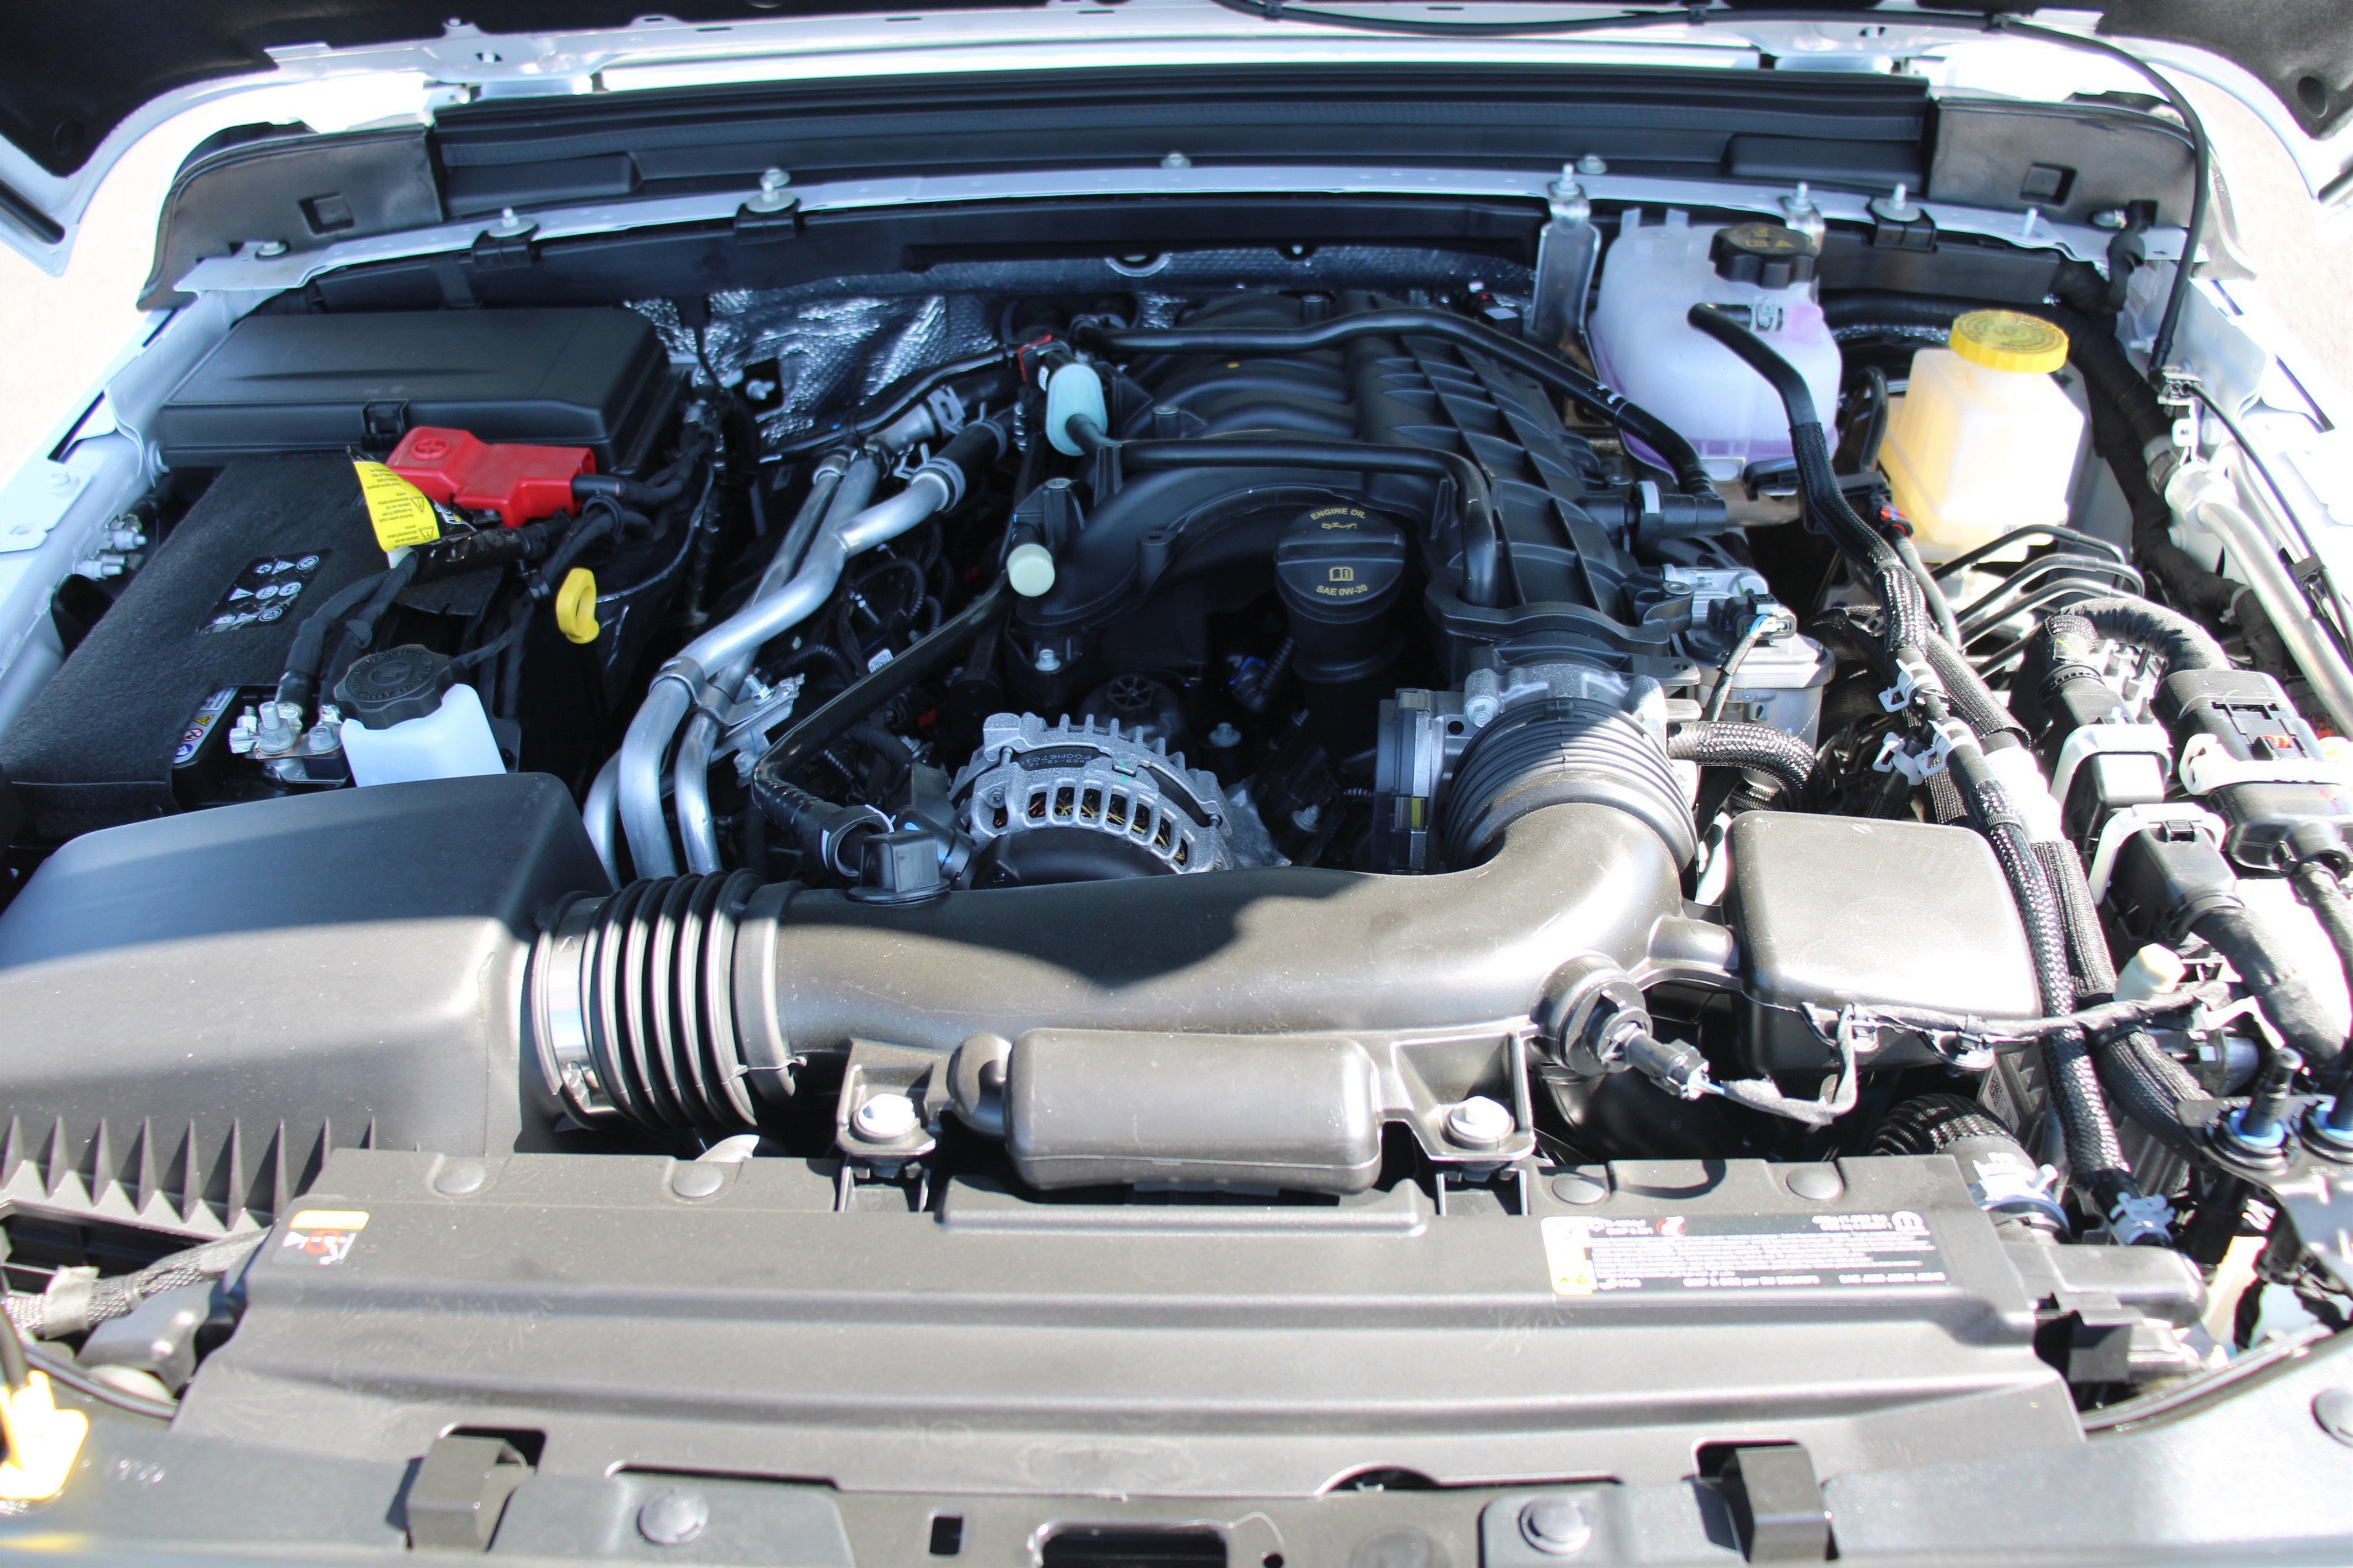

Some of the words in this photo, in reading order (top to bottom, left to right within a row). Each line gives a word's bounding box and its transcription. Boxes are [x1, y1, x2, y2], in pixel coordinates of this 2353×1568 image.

[1310, 508, 1348, 520] ENGINE
[1350, 509, 1366, 519] OIL
[1316, 585, 1337, 596] SAE
[1338, 584, 1368, 596] 0W-20
